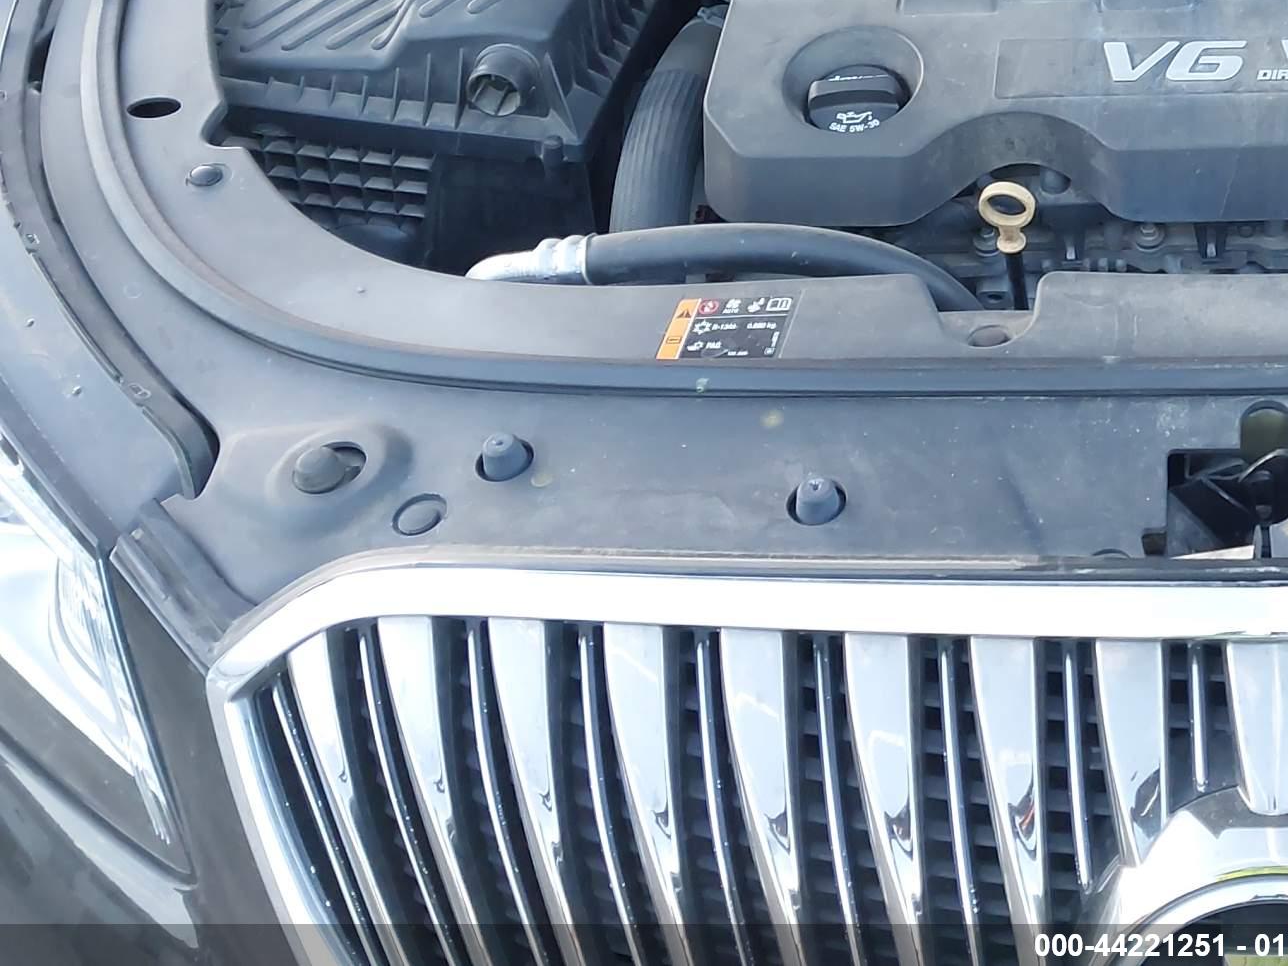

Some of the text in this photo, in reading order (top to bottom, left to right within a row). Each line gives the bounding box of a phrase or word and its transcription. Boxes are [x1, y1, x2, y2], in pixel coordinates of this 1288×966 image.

[1103, 40, 1248, 82] V6
[829, 119, 880, 133] SAE 5W-30
